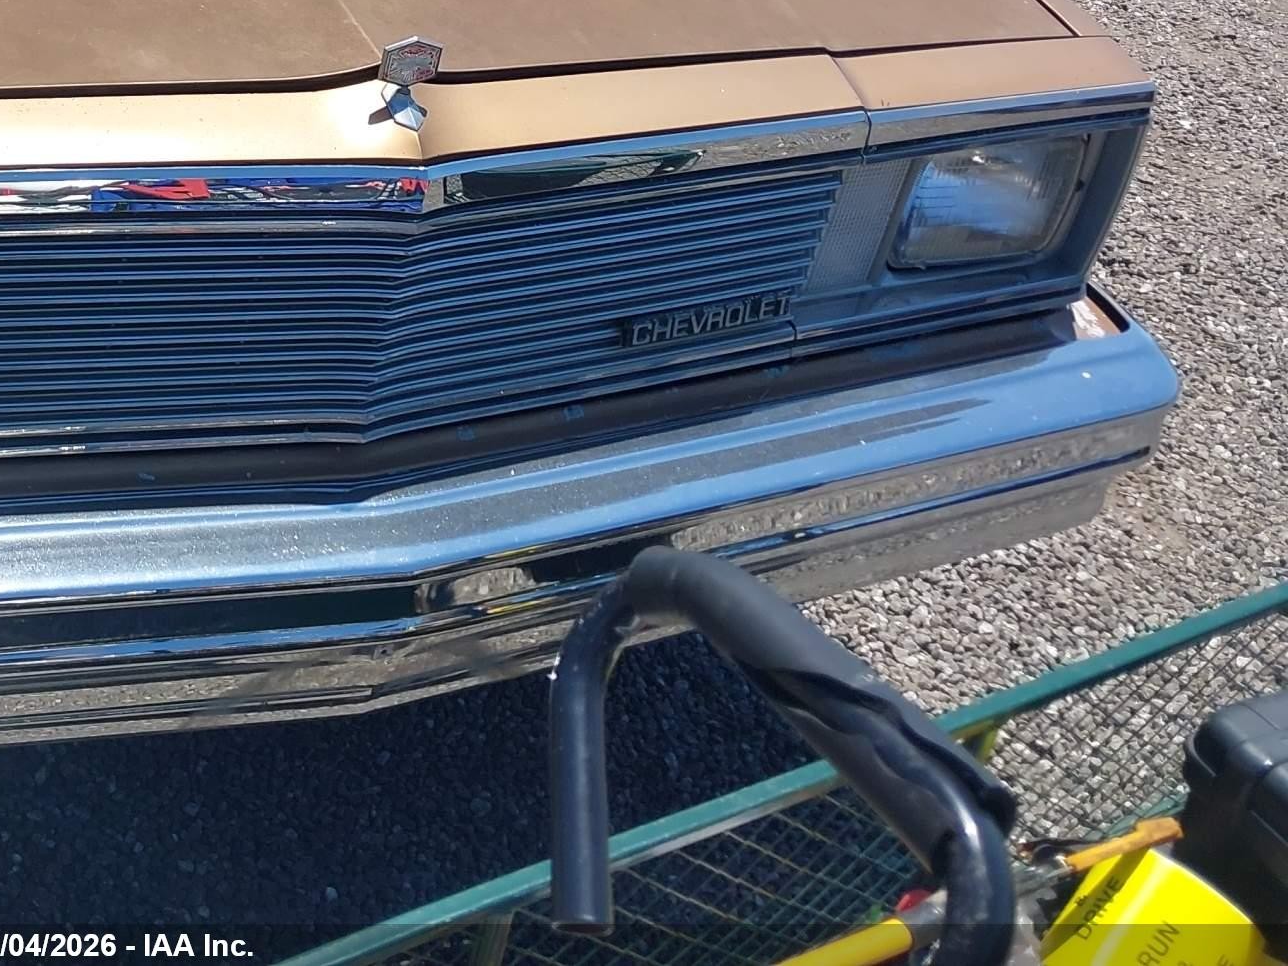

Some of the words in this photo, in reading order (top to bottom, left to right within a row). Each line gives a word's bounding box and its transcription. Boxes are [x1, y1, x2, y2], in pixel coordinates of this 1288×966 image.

[631, 297, 792, 347] CHEVROLET
[1074, 876, 1121, 940] DRIVE
[1136, 920, 1181, 966] RUN
